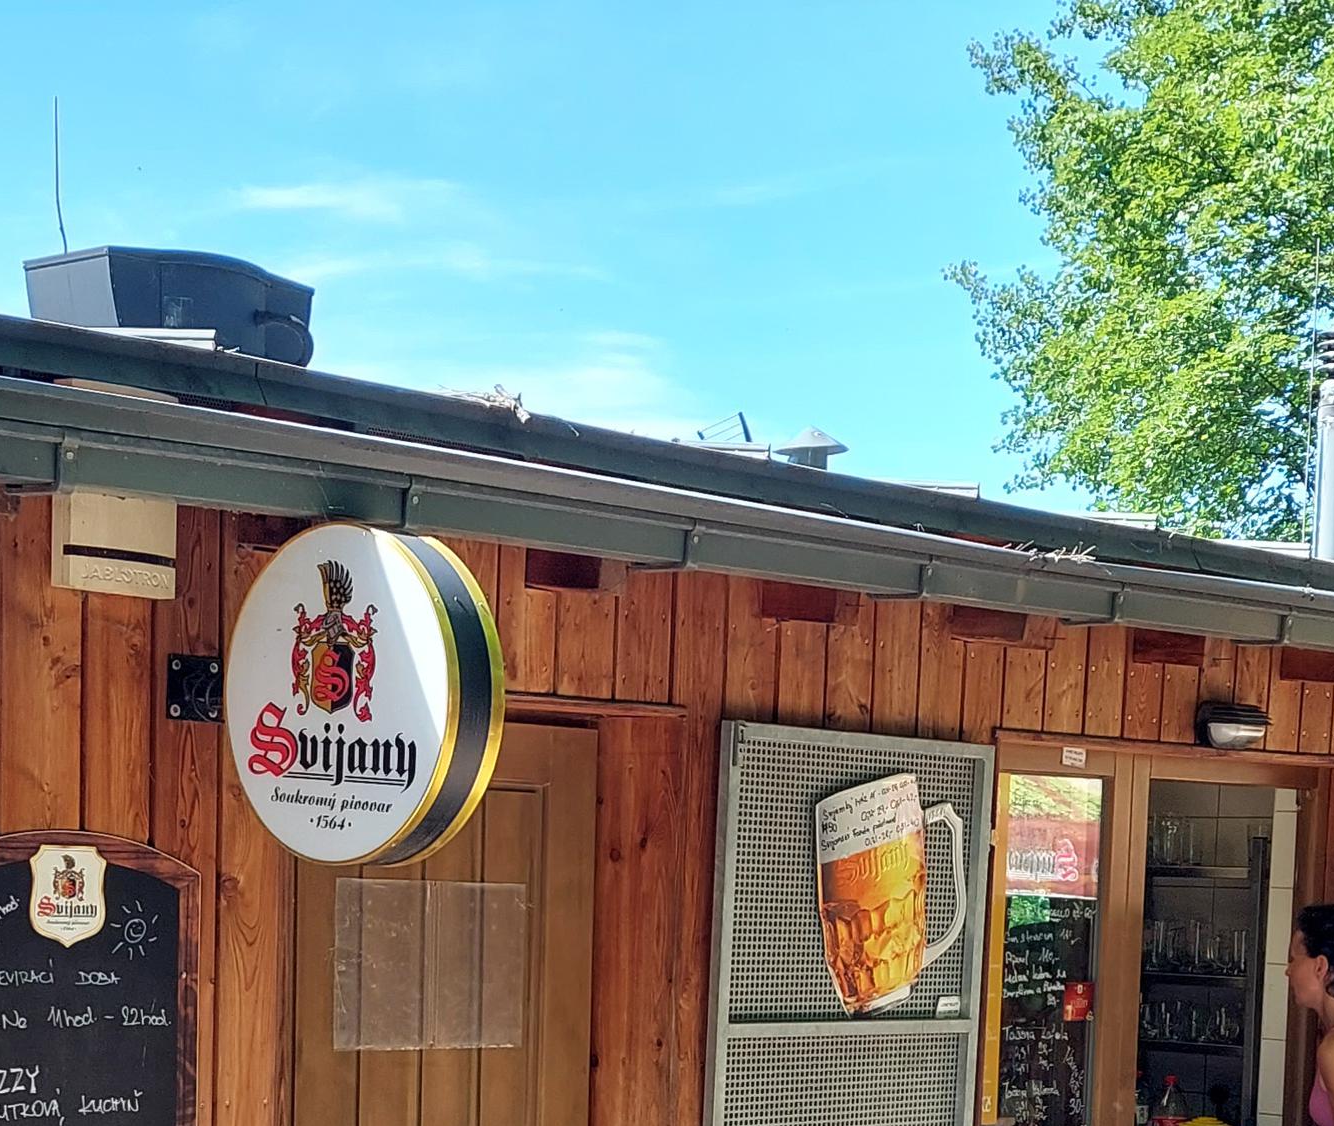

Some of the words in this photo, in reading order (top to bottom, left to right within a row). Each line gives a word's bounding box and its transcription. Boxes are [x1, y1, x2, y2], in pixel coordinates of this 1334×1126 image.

[81, 563, 170, 589] JABLOTRON
[247, 702, 418, 793] Svijany
[271, 786, 336, 810] Soukromý
[340, 795, 393, 813] pivovar
[37, 896, 97, 918] Svijany
[75, 971, 121, 985] DOBA
